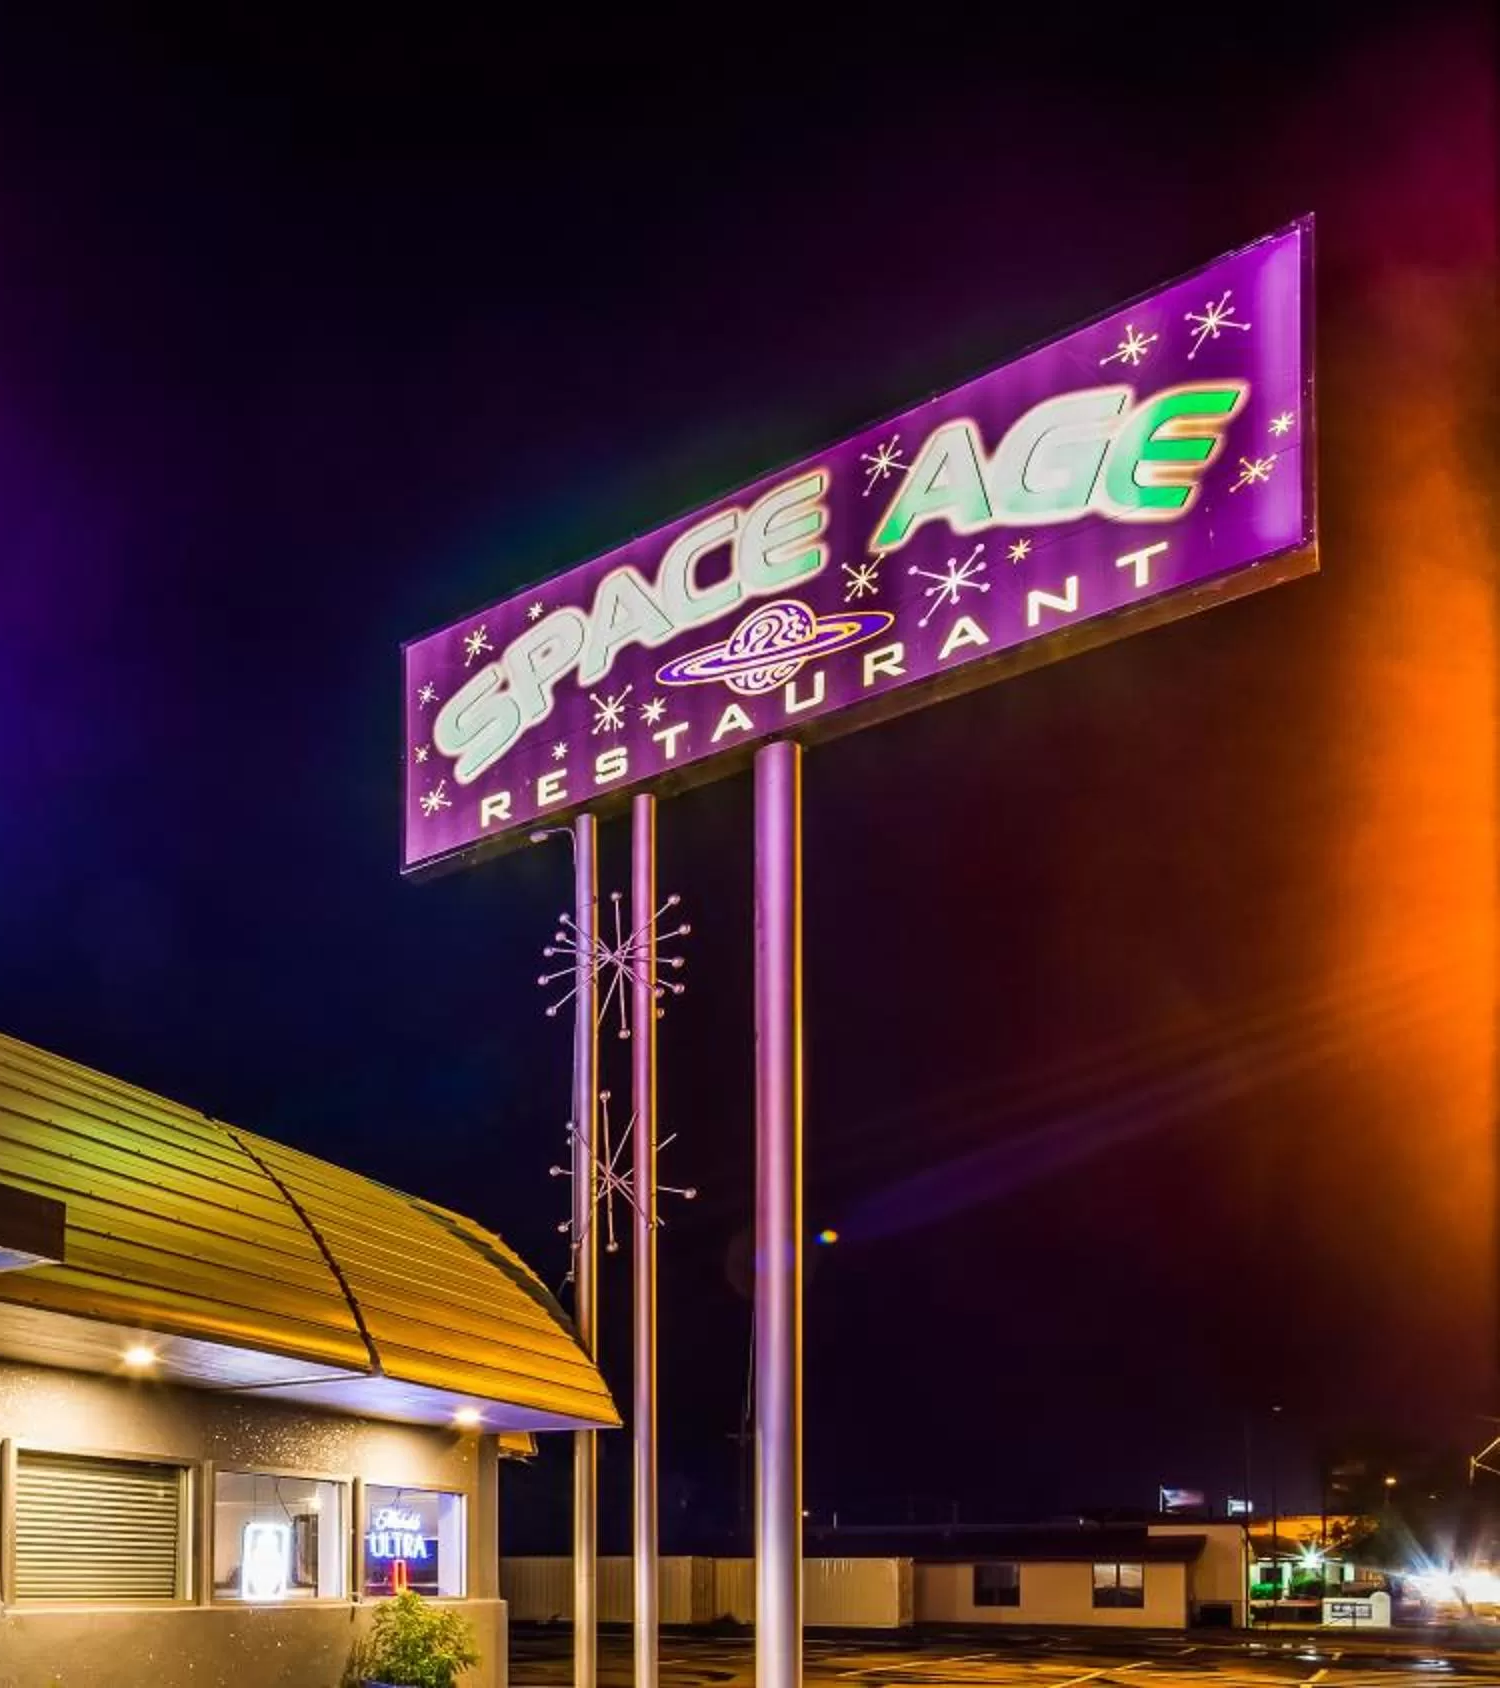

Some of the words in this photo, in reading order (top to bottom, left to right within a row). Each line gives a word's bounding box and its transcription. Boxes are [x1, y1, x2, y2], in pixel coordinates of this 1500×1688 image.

[436, 469, 829, 783] SPACE
[869, 381, 1249, 552] AGE
[480, 541, 1170, 827] RESTAURANT
[371, 1531, 426, 1558] ULTRA
